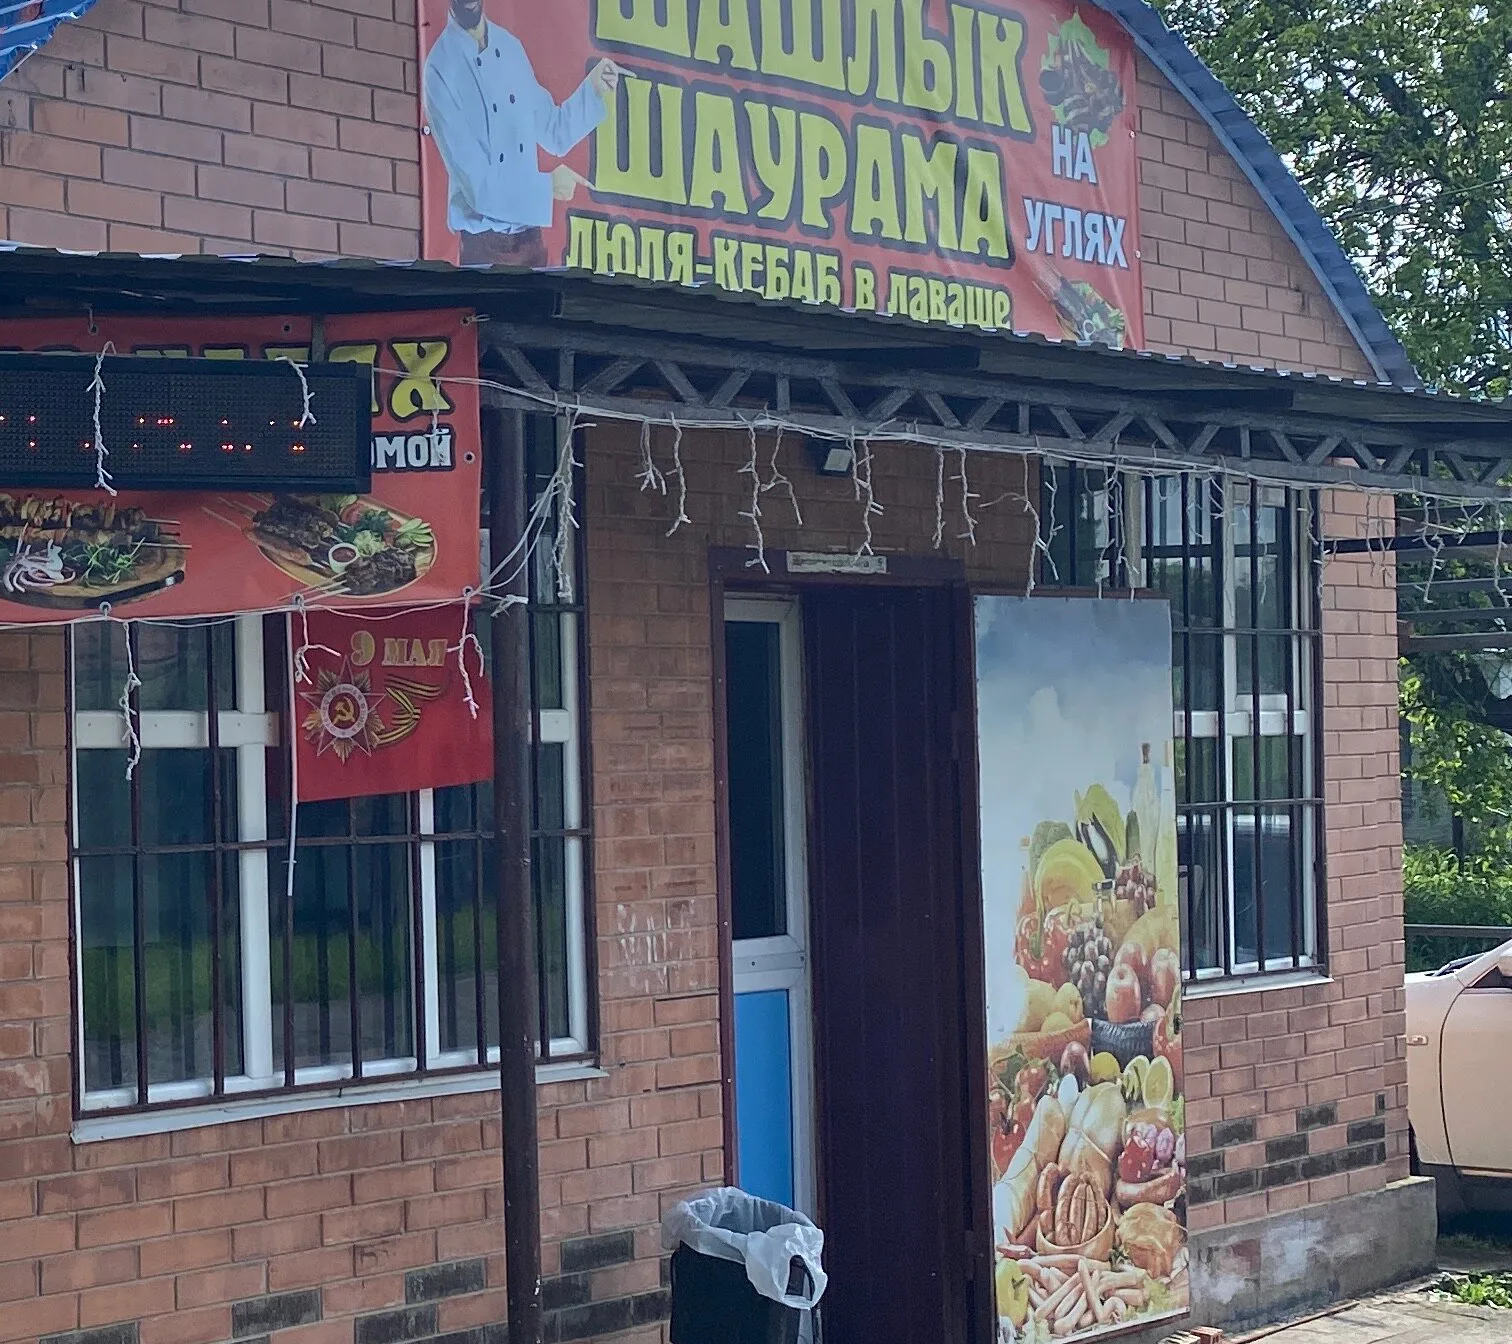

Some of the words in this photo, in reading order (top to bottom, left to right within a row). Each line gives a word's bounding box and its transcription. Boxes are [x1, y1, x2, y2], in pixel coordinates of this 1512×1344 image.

[591, 68, 1013, 261] ШАУРАМА
[1052, 123, 1096, 185] НА
[1023, 196, 1130, 269] УГЛЯХ
[564, 213, 842, 308] ЛЮЛЯ-КЕБАБ
[887, 273, 1013, 330] лаваше
[371, 427, 453, 469] МОЙ
[350, 630, 376, 667] 9
[381, 637, 449, 667] МАЯ
